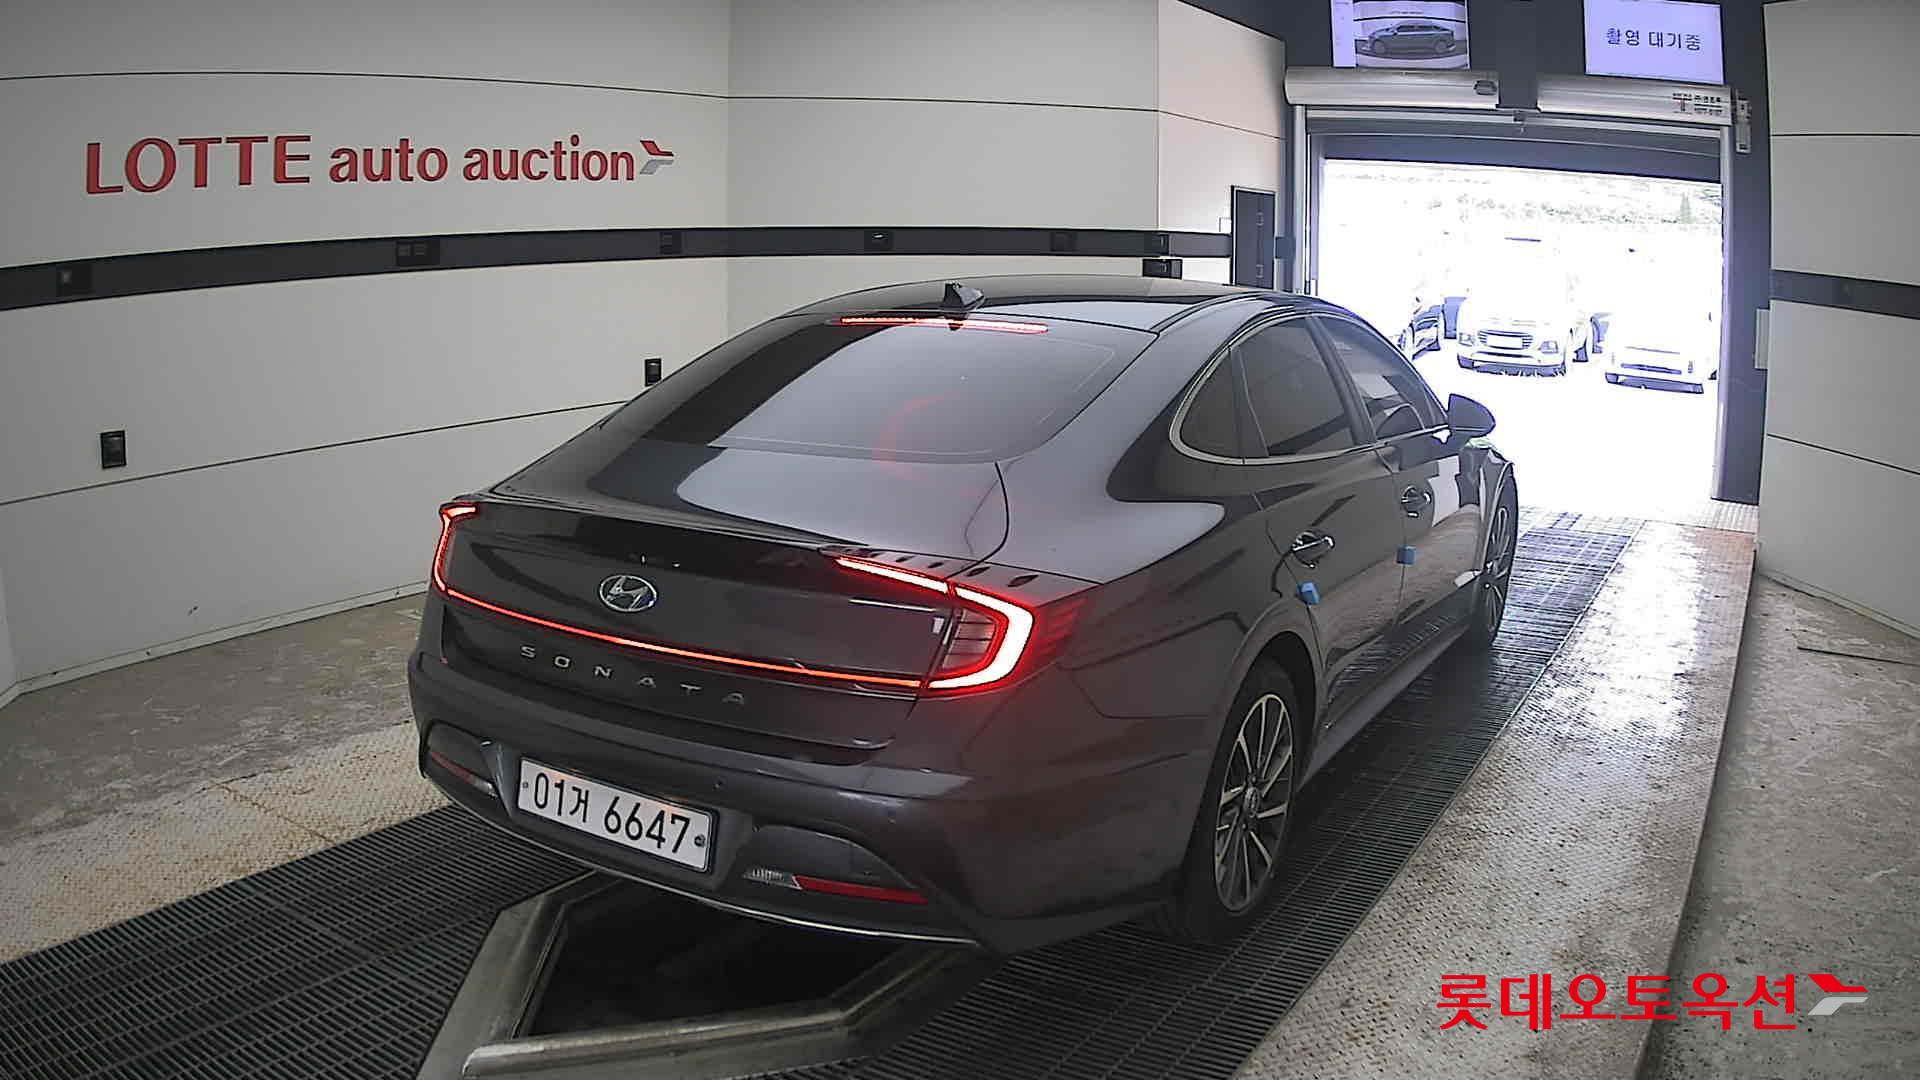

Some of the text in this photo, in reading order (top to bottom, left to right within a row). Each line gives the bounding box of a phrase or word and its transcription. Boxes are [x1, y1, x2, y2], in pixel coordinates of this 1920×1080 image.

[1648, 31, 1701, 51] 대기중
[86, 134, 634, 194] LOTTE auto auction
[520, 645, 745, 705] SONATA
[534, 772, 690, 853] 01거 6647
